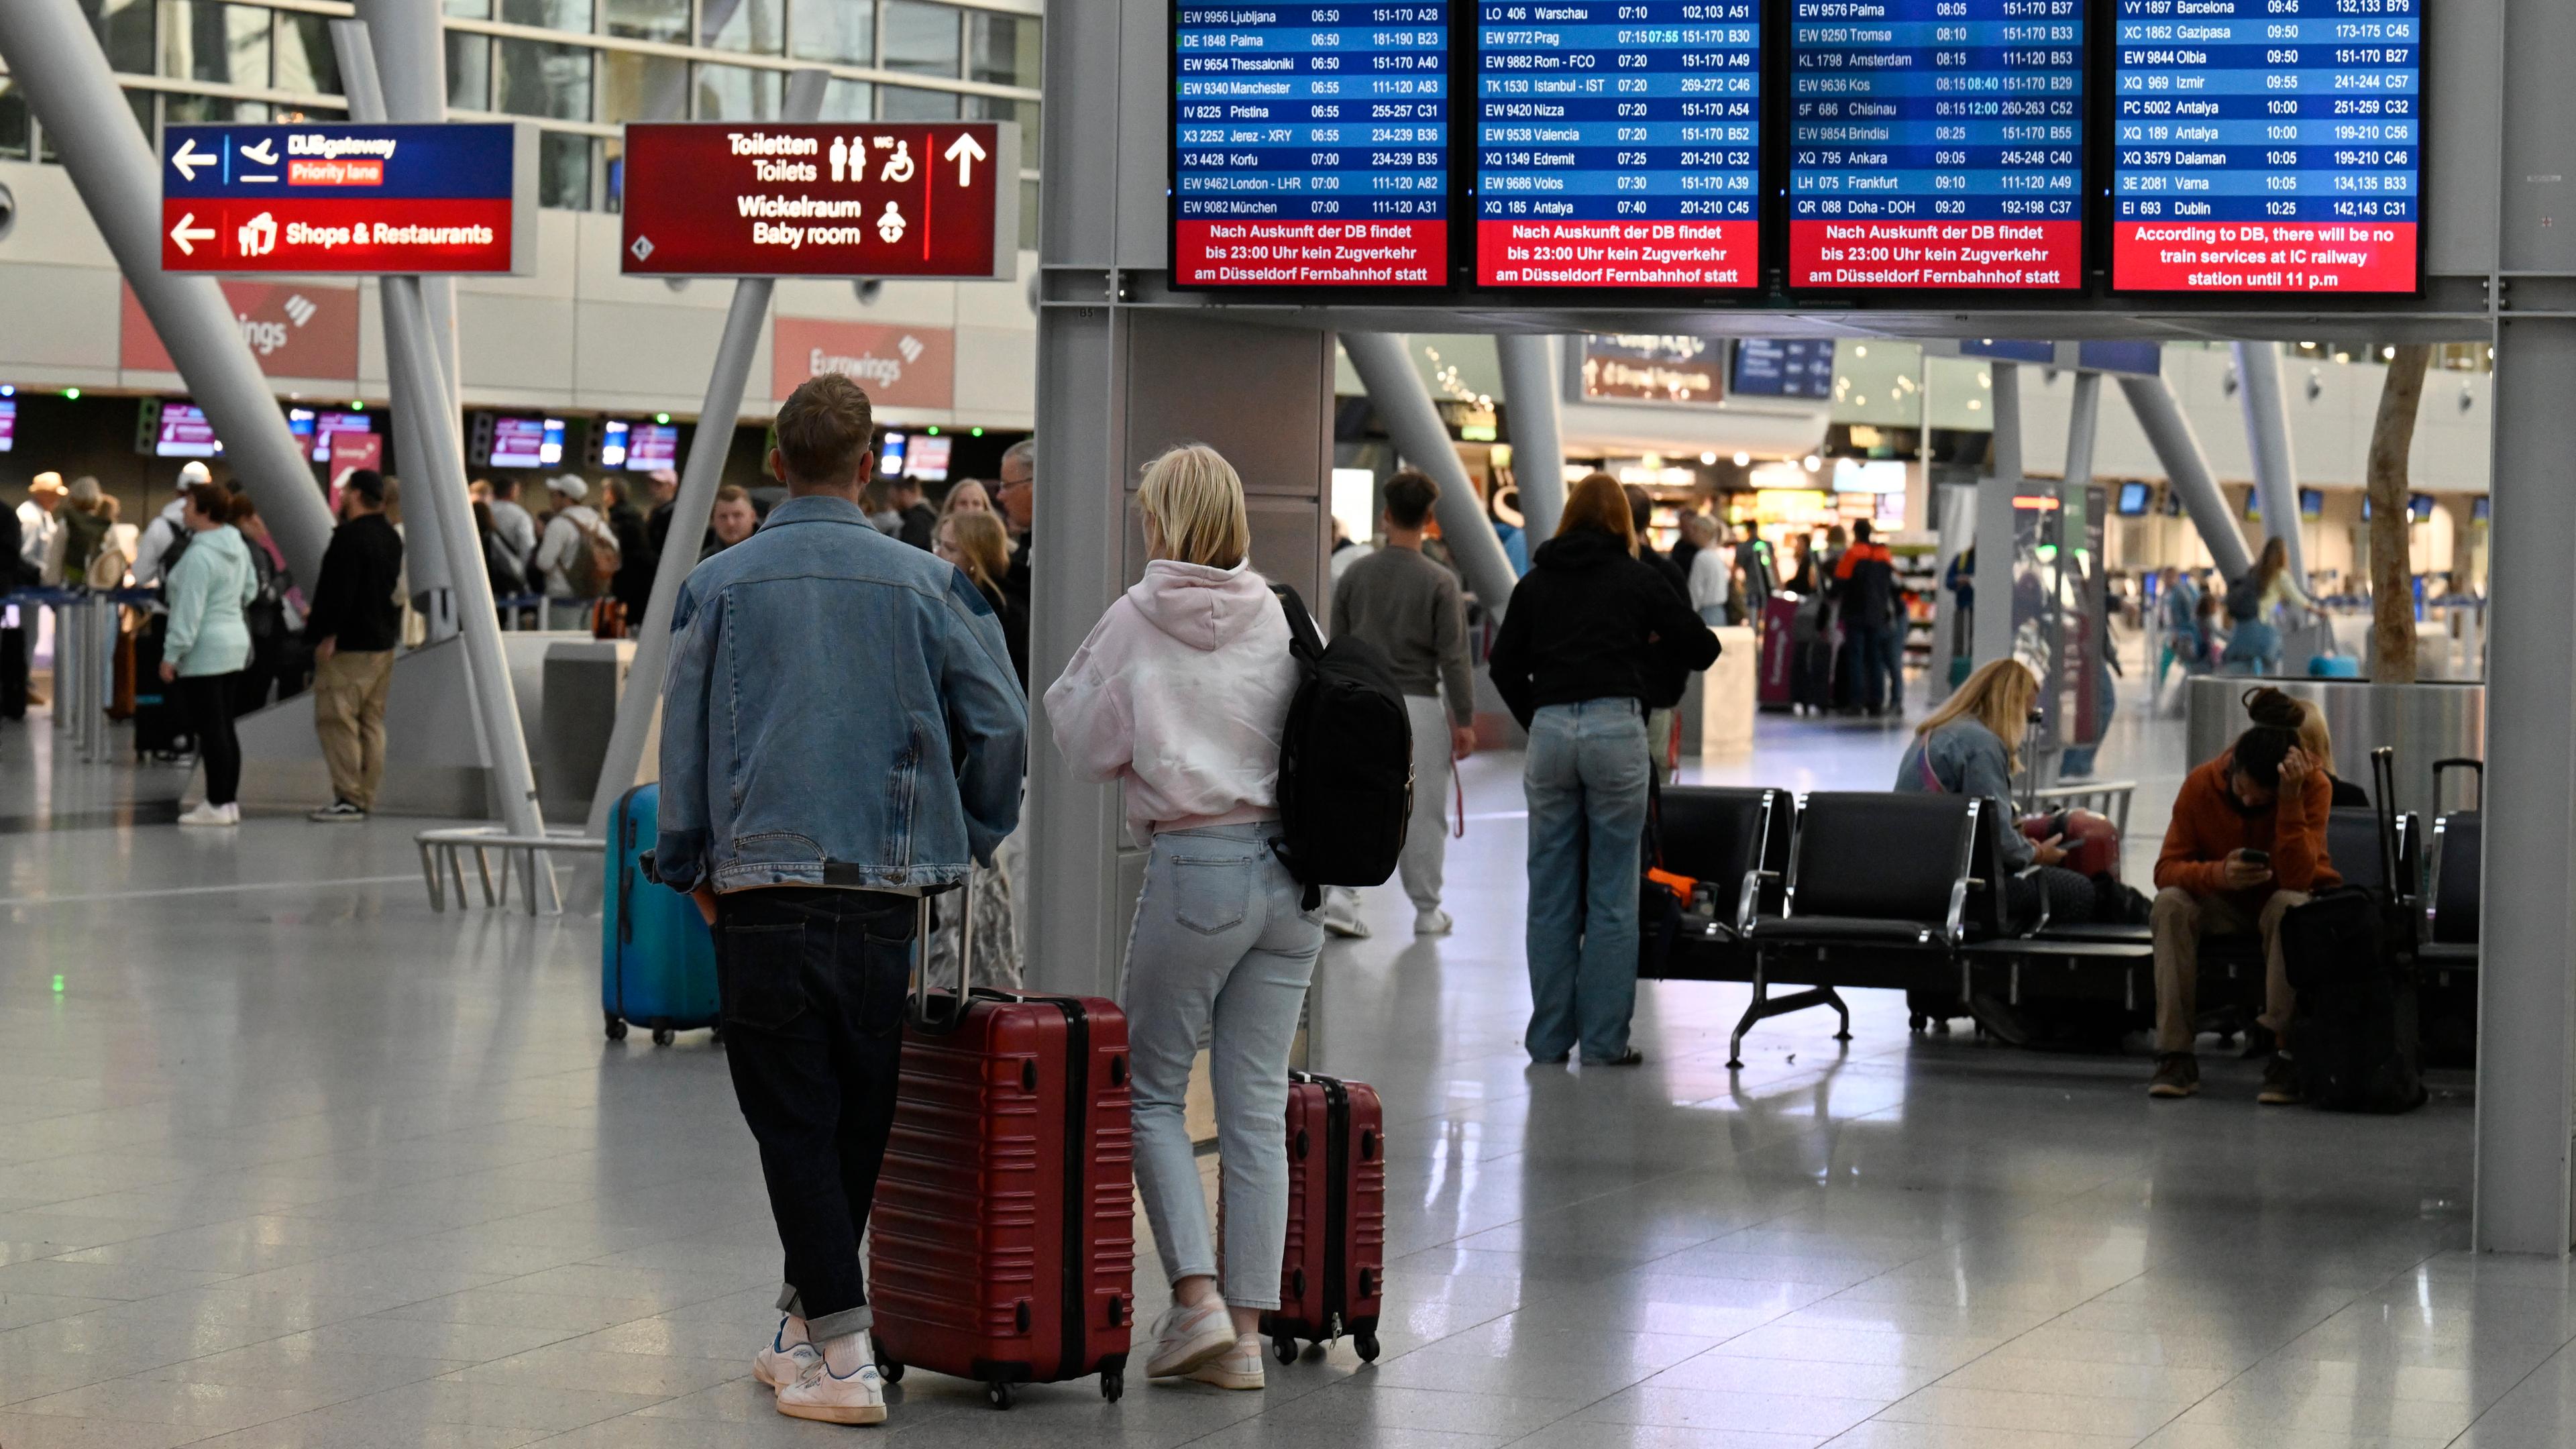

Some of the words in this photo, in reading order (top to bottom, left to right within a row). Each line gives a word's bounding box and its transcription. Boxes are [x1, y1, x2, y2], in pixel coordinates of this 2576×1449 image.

[1487, 8, 1501, 19] LO
[1507, 7, 1525, 19] 406
[1535, 7, 1587, 19] Warschau
[1619, 7, 1647, 19] 07:10
[1682, 5, 1723, 19] 102,103
[1729, 5, 1748, 17] A51
[1184, 36, 1199, 46] DE
[1203, 35, 1226, 46] 1848
[1231, 35, 1263, 46] Palma
[1312, 34, 1339, 46] 06:50
[1373, 33, 1413, 45] 181-190
[1418, 33, 1438, 44] B23
[1800, 30, 1819, 42] EW
[1821, 29, 1847, 42] 9250
[1850, 28, 1891, 41] Tromsø
[1937, 28, 1966, 40] 08:10
[2003, 27, 2045, 40] 151-170
[2051, 27, 2072, 40] B33
[1184, 59, 1202, 70] EW
[1204, 58, 1228, 70] 9654
[1231, 58, 1293, 70] Thessaloniki
[1311, 57, 1339, 69] 06:50
[1800, 55, 1813, 66] KL
[1817, 54, 1841, 66] 1798
[1849, 54, 1911, 66] Amsterdam
[1937, 52, 1966, 65] 08:15
[2003, 52, 2045, 64] 111-120
[2051, 52, 2072, 64] B53
[1185, 107, 1194, 117] IV
[1197, 106, 1221, 118] 8225
[1231, 106, 1269, 117] Pristina
[1311, 105, 1339, 117] 06:55
[1373, 105, 1412, 117] 255-257
[1417, 105, 1436, 117] C31
[2125, 101, 2140, 114] PC
[2144, 101, 2170, 113] 5002
[2176, 101, 2218, 116] Antalya
[2267, 101, 2297, 113] 10:00
[2334, 101, 2379, 113] 251-259
[2385, 100, 2408, 113] C32
[728, 133, 818, 155] Toiletten
[873, 136, 894, 148] WC
[1486, 153, 1502, 165] XQ
[1505, 153, 1529, 164] 1349
[1534, 153, 1574, 165] Edremit
[1618, 152, 1646, 164] 07:25
[1681, 152, 1723, 164] 201-210
[1728, 152, 1749, 164] C32
[2123, 152, 2141, 164] XQ
[2144, 152, 2171, 164] 3579
[2176, 152, 2226, 164] Dalaman
[2267, 152, 2296, 164] 10:05
[2334, 151, 2378, 164] 199-210
[2385, 151, 2407, 164] C46
[292, 163, 345, 183] Priority
[347, 164, 378, 180] lane
[753, 159, 817, 181] Toilets
[1799, 177, 1813, 189] LH
[1819, 176, 1839, 189] 075
[1849, 176, 1898, 189] Frankfurt
[1936, 176, 1965, 189] 09:10
[2002, 176, 2044, 188] 111-120
[2050, 176, 2071, 188] A49
[738, 195, 861, 217] Wickelraum
[1184, 201, 1201, 213] EW
[1204, 201, 1228, 213] 9082
[1231, 201, 1277, 213] München
[1311, 201, 1338, 213] 07:00
[1373, 201, 1412, 213] 111-120
[1417, 201, 1436, 213] A31
[1485, 201, 1501, 213] XQ
[1508, 201, 1526, 213] 185
[1534, 201, 1573, 216] Antalya
[1618, 201, 1646, 213] 07:40
[1681, 201, 1722, 213] 201-210
[1728, 201, 1749, 213] C45
[2141, 202, 2161, 214] 693
[2175, 202, 2210, 215] Dublin
[2266, 202, 2296, 215] 10:25
[2334, 202, 2377, 216] 142,143
[2384, 202, 2405, 215] C31
[286, 222, 350, 249] Shops
[353, 223, 370, 244] &
[374, 223, 493, 244] Restaurants
[753, 221, 804, 250] Baby
[808, 227, 860, 244] room
[1211, 225, 1246, 237] Nach
[1250, 225, 1314, 237] Auskunft
[1318, 225, 1342, 237] der
[1346, 225, 1366, 237] DB
[1371, 225, 1411, 237] findet
[1513, 225, 1550, 238] Nach
[1554, 225, 1620, 239] Auskunft
[1624, 225, 1649, 239] der
[1653, 225, 1674, 238] DB
[1679, 225, 1721, 239] findet
[1827, 225, 1865, 238] Nach
[1870, 225, 1938, 239] Auskunft
[1943, 225, 1968, 239] der
[1972, 225, 1994, 239] DB
[1999, 225, 2043, 239] findet
[2135, 227, 2215, 244] According
[2220, 227, 2236, 241] to
[2241, 227, 2268, 243] DB,
[2273, 227, 2314, 241] there
[2318, 227, 2344, 241] will
[2350, 227, 2369, 241] be
[2373, 231, 2394, 241] no
[1206, 246, 1226, 258] bis
[1231, 246, 1268, 258] 23:00
[1273, 246, 1298, 258] Uhr
[1302, 246, 1331, 258] kein
[1335, 246, 1417, 262] Zugverkehr
[1508, 247, 1529, 260] bis
[1534, 247, 1572, 260] 23:00
[1577, 247, 1604, 260] Uhr
[1608, 247, 1638, 260] kein
[1642, 247, 1727, 264] Zugverkehr
[1822, 248, 1843, 260] bis
[1849, 248, 1888, 260] 23:00
[1894, 248, 1921, 260] Uhr
[1925, 248, 1956, 261] kein
[1961, 248, 2048, 264] Zugverkehr
[2161, 250, 2196, 262] train
[2201, 250, 2266, 263] services
[2271, 250, 2286, 263] at
[2291, 250, 2306, 263] IC
[2312, 250, 2367, 267] railway
[1195, 270, 1216, 279] am
[1220, 267, 1297, 280] Düsseldorf
[1301, 268, 1391, 280] Fernbahnhof
[1395, 268, 1427, 280] statt
[1497, 271, 1517, 280] am
[1523, 268, 1603, 281] Düsseldorf
[1607, 268, 1701, 282] Fernbahnhof
[1705, 270, 1737, 282] statt
[1809, 272, 1831, 282] am
[1837, 269, 1919, 282] Düsseldorf
[1924, 270, 2021, 283] Fernbahnhof
[2025, 270, 2059, 283] statt
[2188, 272, 2242, 285] station
[2247, 272, 2281, 286] until
[2286, 272, 2302, 285] 11
[2309, 275, 2338, 289] p.m
